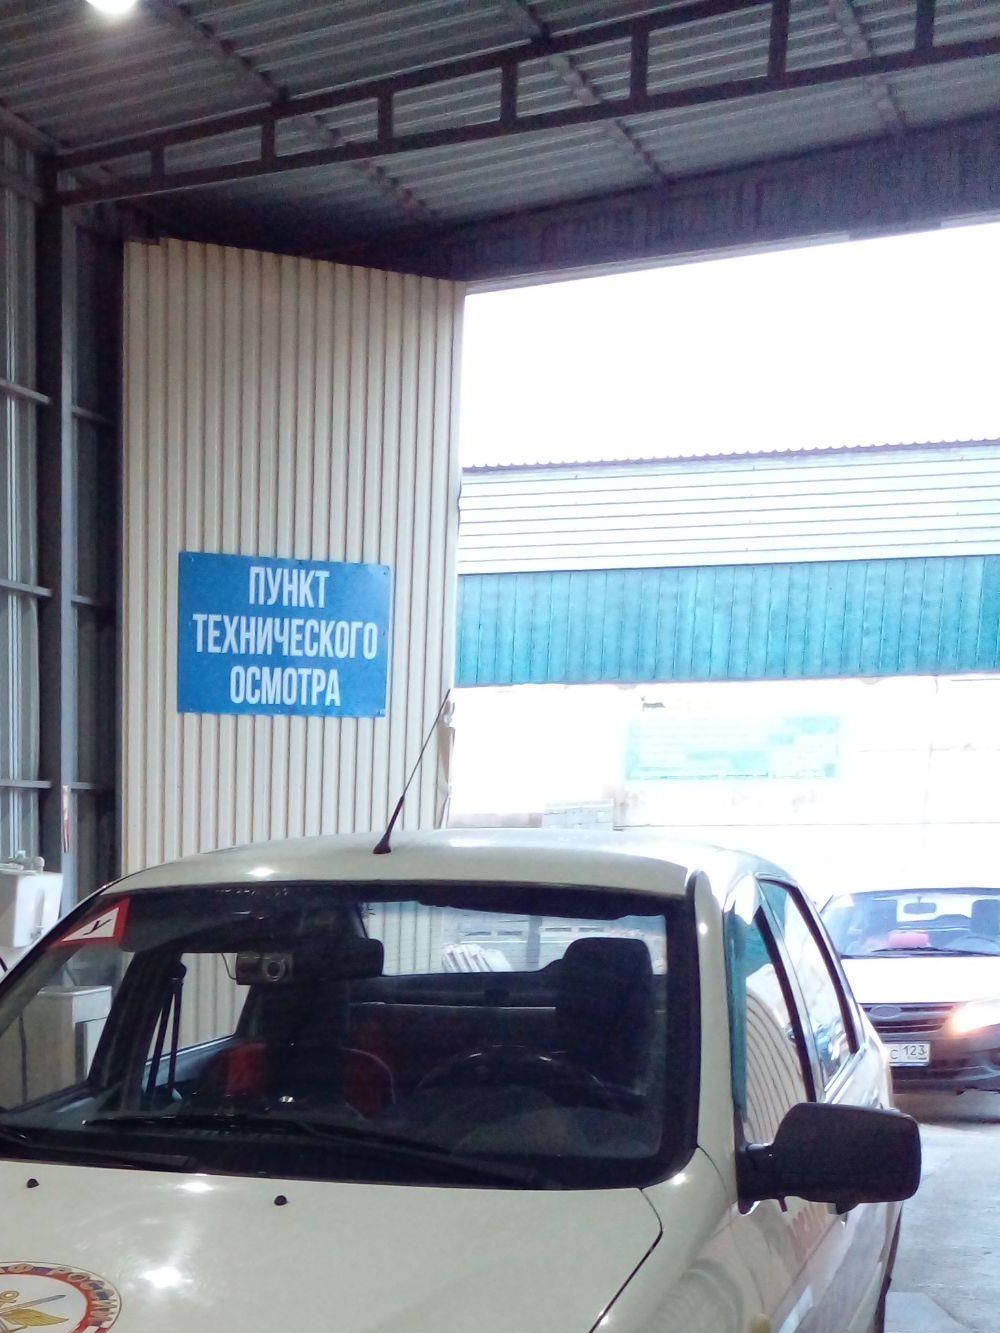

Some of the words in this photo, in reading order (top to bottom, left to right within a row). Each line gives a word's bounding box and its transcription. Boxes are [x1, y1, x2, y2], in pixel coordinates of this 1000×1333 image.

[249, 566, 330, 608] ПУНКТ
[192, 613, 378, 660] ТЕХНИЧЕСКОГО
[230, 666, 341, 706] ОСМОТРА
[902, 1045, 926, 1056] 123
